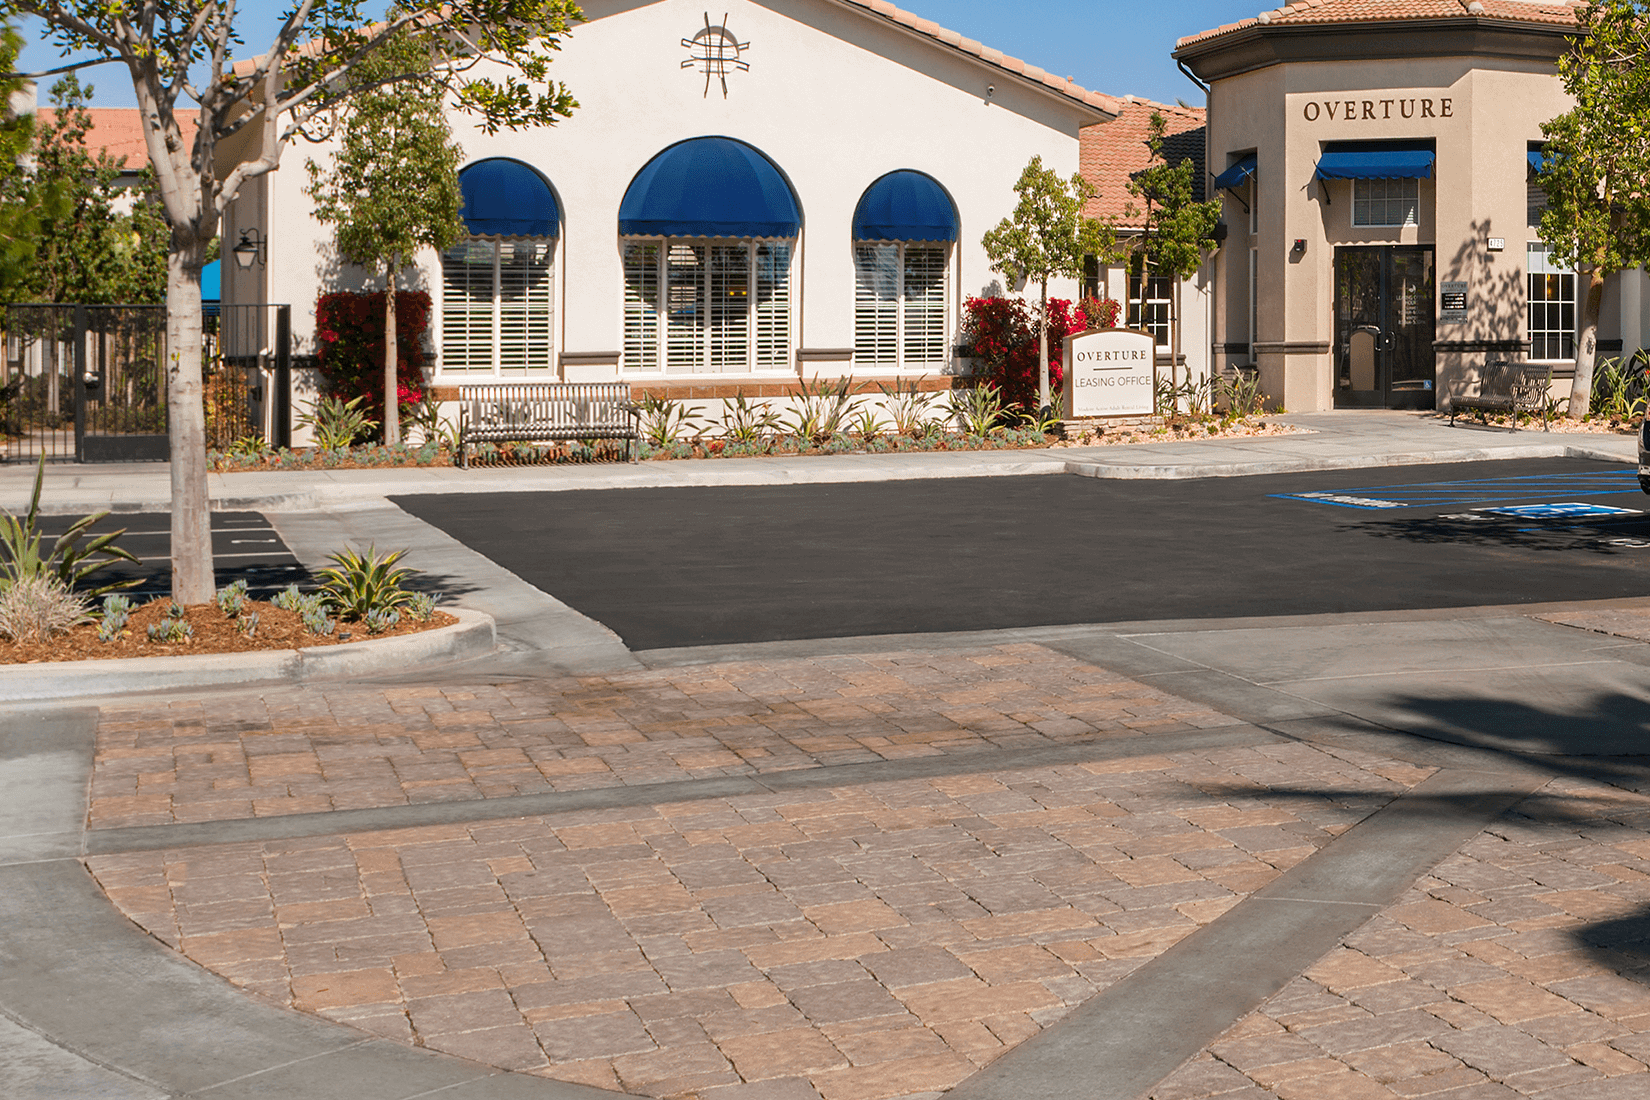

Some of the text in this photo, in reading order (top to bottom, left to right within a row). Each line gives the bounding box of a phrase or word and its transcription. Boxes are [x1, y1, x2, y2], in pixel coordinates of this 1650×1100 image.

[1303, 98, 1454, 122] OVERTURE
[1076, 349, 1147, 362] OVERTURE
[1075, 375, 1152, 388] LEASING OFFICE
